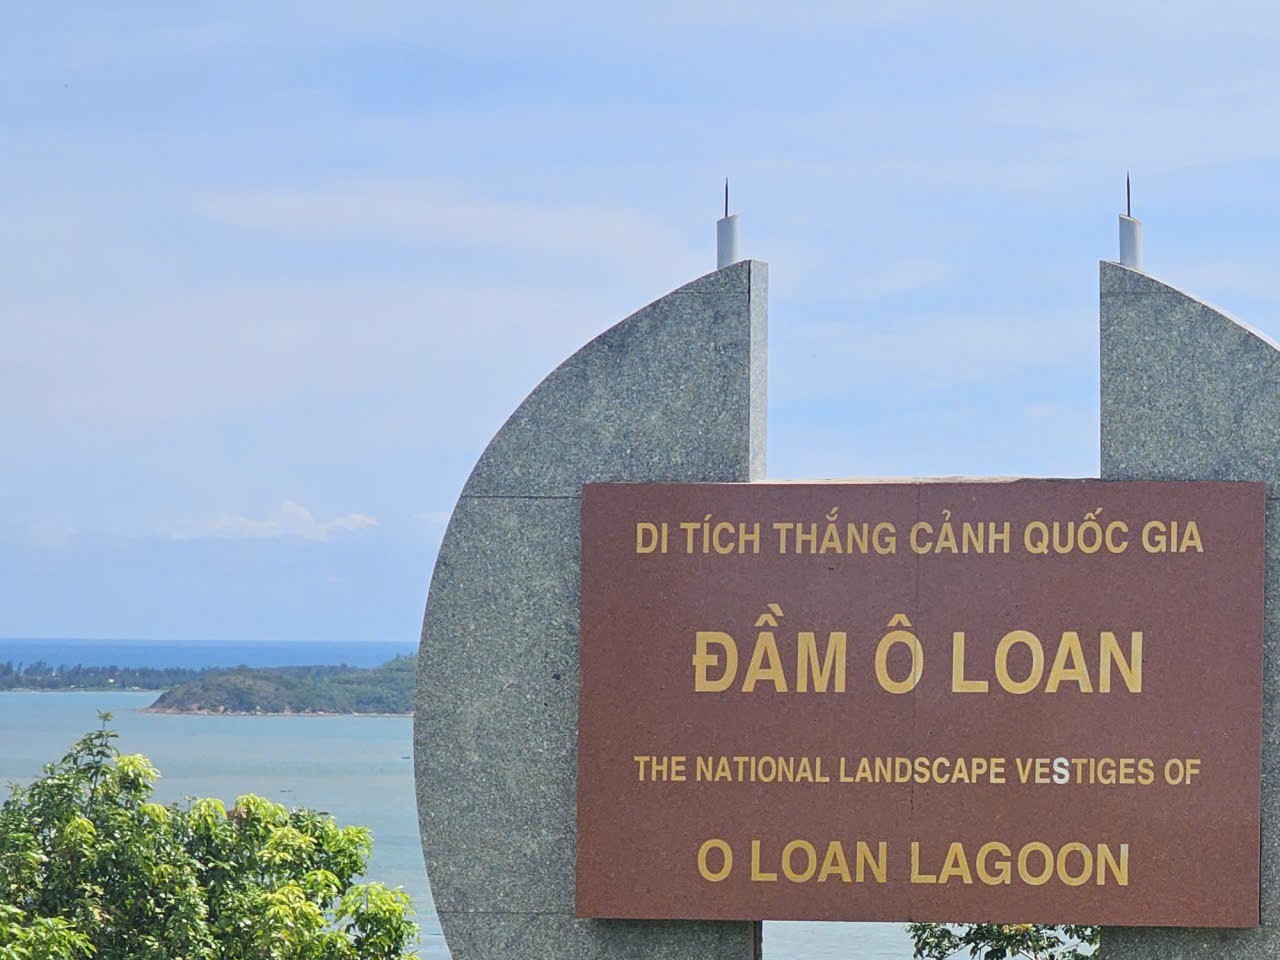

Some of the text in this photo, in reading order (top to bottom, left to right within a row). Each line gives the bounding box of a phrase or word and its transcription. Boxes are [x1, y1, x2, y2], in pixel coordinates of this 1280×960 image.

[635, 506, 1204, 555] DI TÍCH THẮNG CẢNH QUỐC GIA
[692, 602, 1144, 695] ĐẦM Ô LOAN
[634, 755, 1202, 785] THE NATIONAL LANDSCAPE VESTIGES OF
[697, 838, 1130, 886] O LOAN LAGOON
